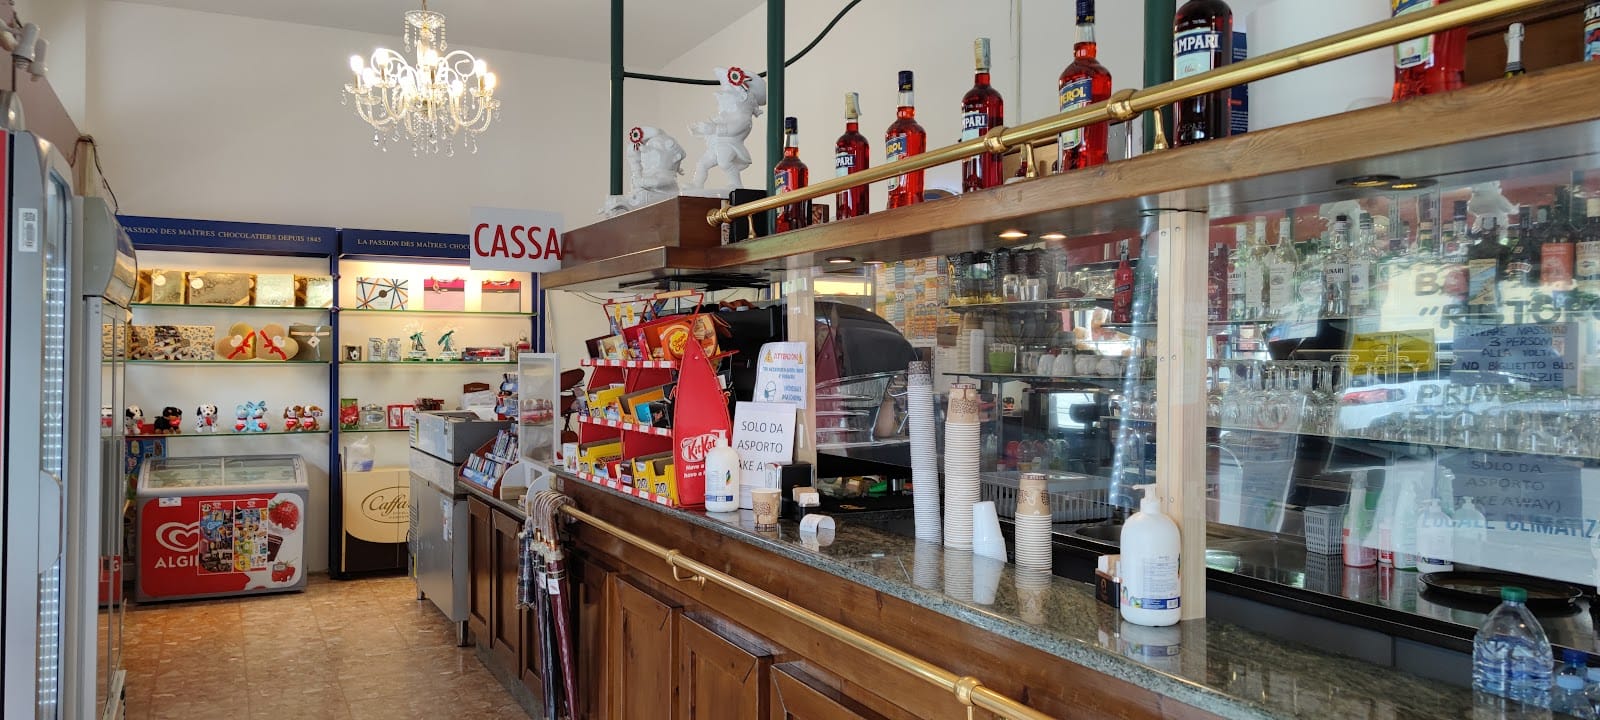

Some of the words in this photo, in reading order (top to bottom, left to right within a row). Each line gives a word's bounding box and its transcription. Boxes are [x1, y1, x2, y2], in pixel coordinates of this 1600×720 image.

[160, 227, 177, 236] DES
[178, 227, 216, 238] MAÎTRES
[217, 230, 277, 241] CHOCOLATIERS
[277, 233, 306, 243] DEPUIS
[473, 222, 562, 261] CASSA
[357, 238, 369, 246] LA
[369, 238, 400, 248] PASSION
[401, 240, 415, 248] DES
[1461, 361, 1480, 371] NO
[1552, 361, 1577, 371] BUS
[741, 420, 768, 434] SOLO
[769, 423, 784, 434] DA
[687, 435, 716, 460] KitKat
[737, 439, 783, 454] ASPORTO
[1471, 460, 1513, 472] SOLO
[1519, 463, 1543, 474] DA
[1464, 477, 1546, 492] ASPORTO
[369, 495, 410, 517] Caffa
